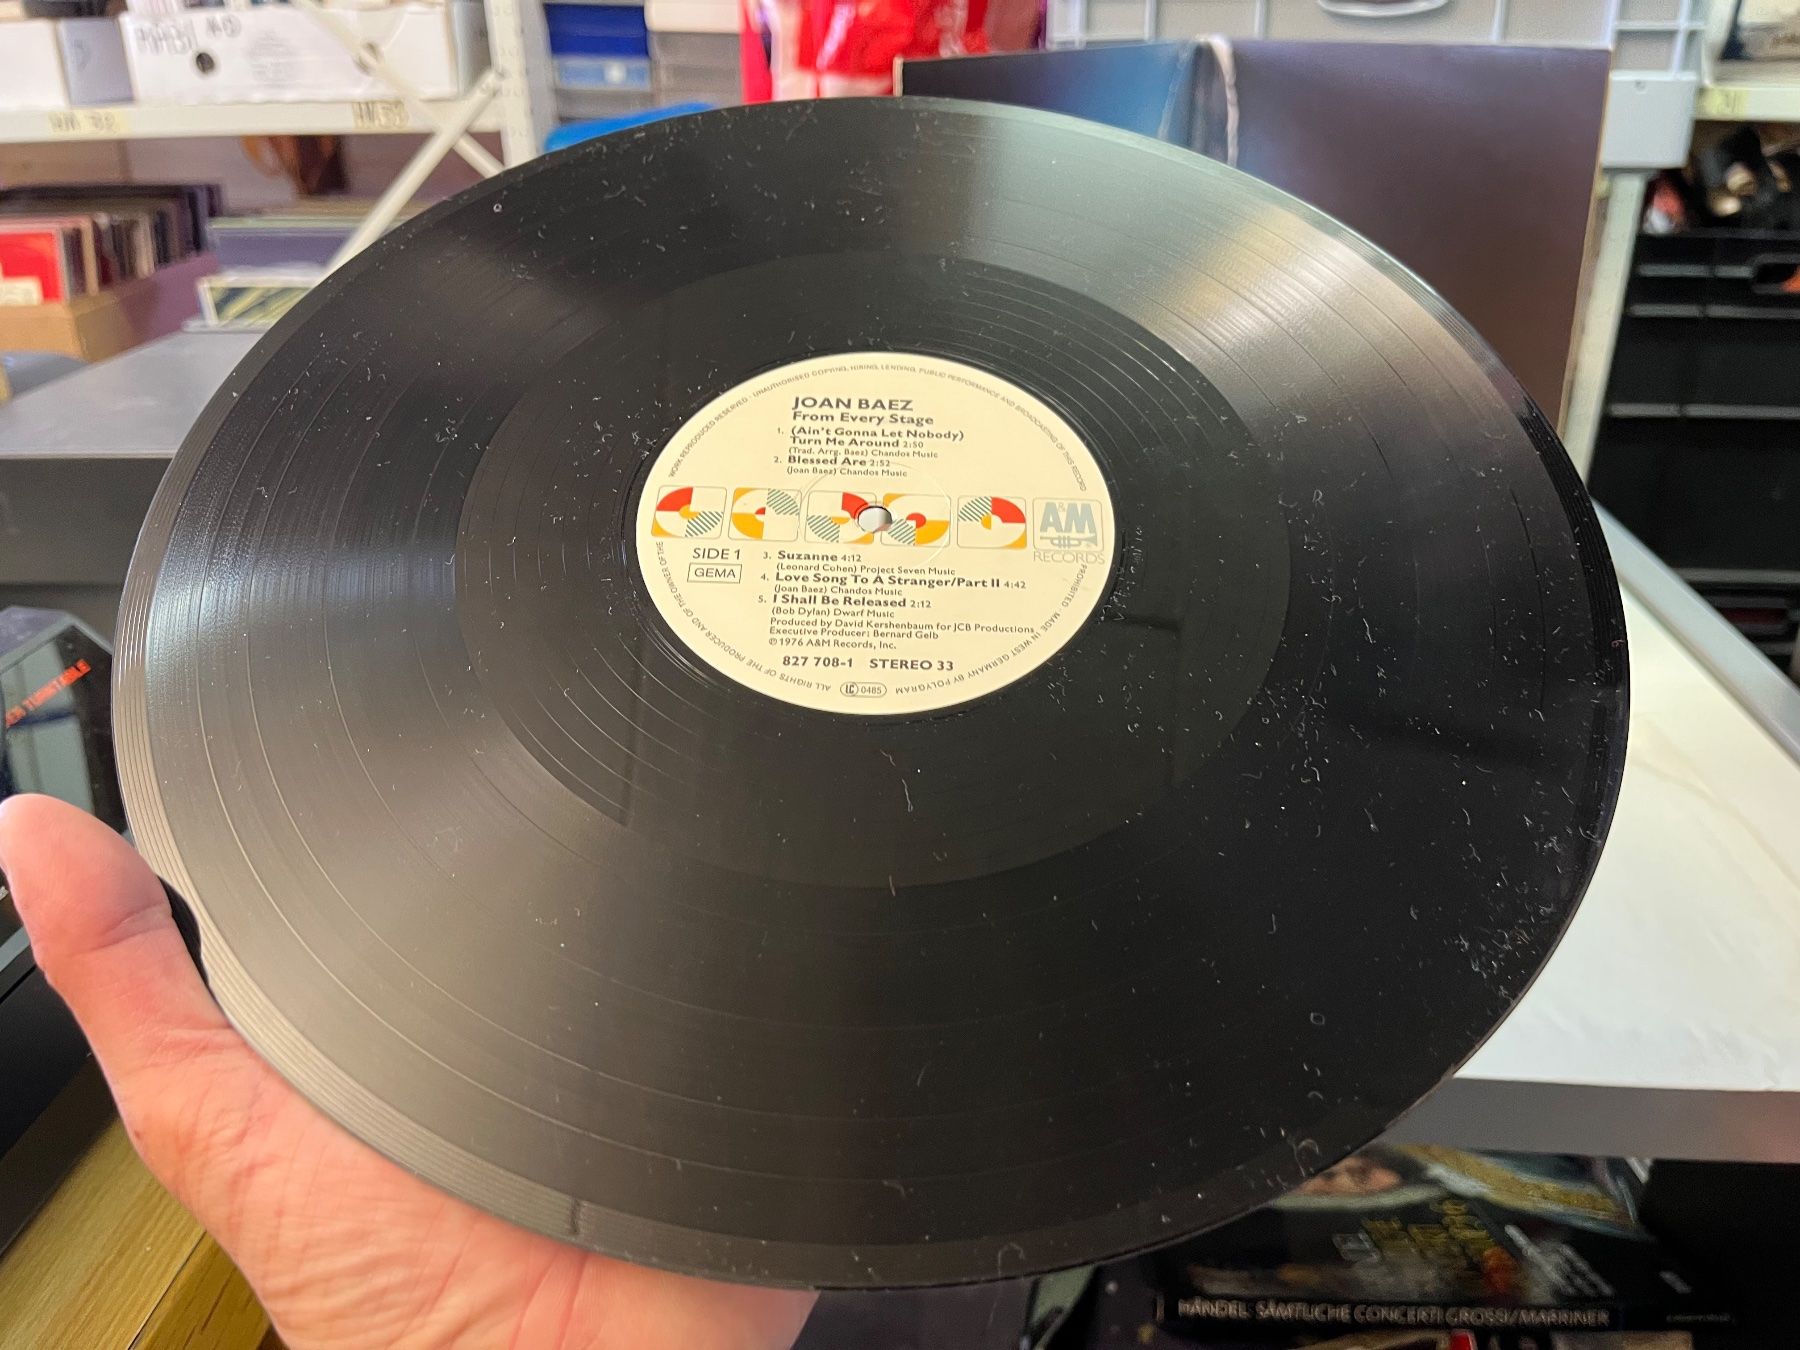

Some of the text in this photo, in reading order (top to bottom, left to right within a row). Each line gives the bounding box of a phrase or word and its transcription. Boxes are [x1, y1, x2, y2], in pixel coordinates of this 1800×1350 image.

[792, 396, 914, 411] JOAN BAEZ
[792, 411, 934, 427] From Every Stage
[668, 458, 683, 478] WORK
[680, 420, 715, 458] REPRODUCED
[714, 397, 748, 421] RESERVED
[752, 373, 810, 398] UNAUTHORISED
[812, 367, 849, 377] COPYING,
[881, 364, 916, 373] LENDING,
[918, 368, 946, 379] PUBLIC
[947, 374, 1000, 398] PERFORMANCE
[1000, 396, 1015, 407] AND
[1015, 405, 1058, 443] BROADCASTING
[1056, 442, 1066, 452] OF
[1063, 450, 1074, 465] THIS
[1072, 465, 1087, 491] RECORD
[777, 425, 964, 442] 1. (Ain't Gonna Let Nobody)
[790, 436, 924, 449] Turn Me Around 2:50
[788, 446, 939, 459] (Trad. Arrg. Baez) Chandos Music
[773, 455, 890, 467] 2. Blessed Are 2:52
[786, 466, 908, 477] (Joan Baez) Chandos Music
[692, 547, 741, 560] SIDE 1
[763, 550, 862, 562] 3. Suzanne 4:12
[1033, 551, 1106, 565] RECORDS
[694, 567, 737, 579] GEMA
[776, 562, 956, 576] (Leonard Cohen) Project Seven Music
[760, 573, 769, 581] 4.
[775, 572, 809, 582] Love
[812, 573, 848, 586] Song
[851, 574, 869, 584] To
[872, 575, 884, 584] A
[888, 575, 988, 588] Stranger/Part
[1003, 581, 1027, 589] 4:42
[774, 584, 903, 596] (Joan Baez) Chandos Music
[758, 594, 932, 608] 5. I Shall Be Released 2:12
[656, 541, 831, 692] ALL RIGHTS OF THE PRODUCER AND OF THE OWNER OF THE
[771, 607, 895, 618] (Bob Dylan) Dwarf Music
[770, 617, 1035, 634] Produced by David Kershenbaum for JCB Productions
[895, 564, 1088, 695] PROHIBITED MADE IN WEST GERMANY BY POLYGRAM
[769, 626, 939, 640] Executive Producer: Bernard Gelb
[806, 638, 831, 647] A&M
[833, 640, 876, 649] Records,
[879, 640, 897, 650] Inc.
[782, 655, 853, 668] 827 708-1
[869, 658, 954, 671] STEREO 33
[845, 683, 882, 695] LC 0485
[1353, 1303, 1441, 1326] CONCERTI
[1445, 1306, 1610, 1328] GROSSI/MARRINER
